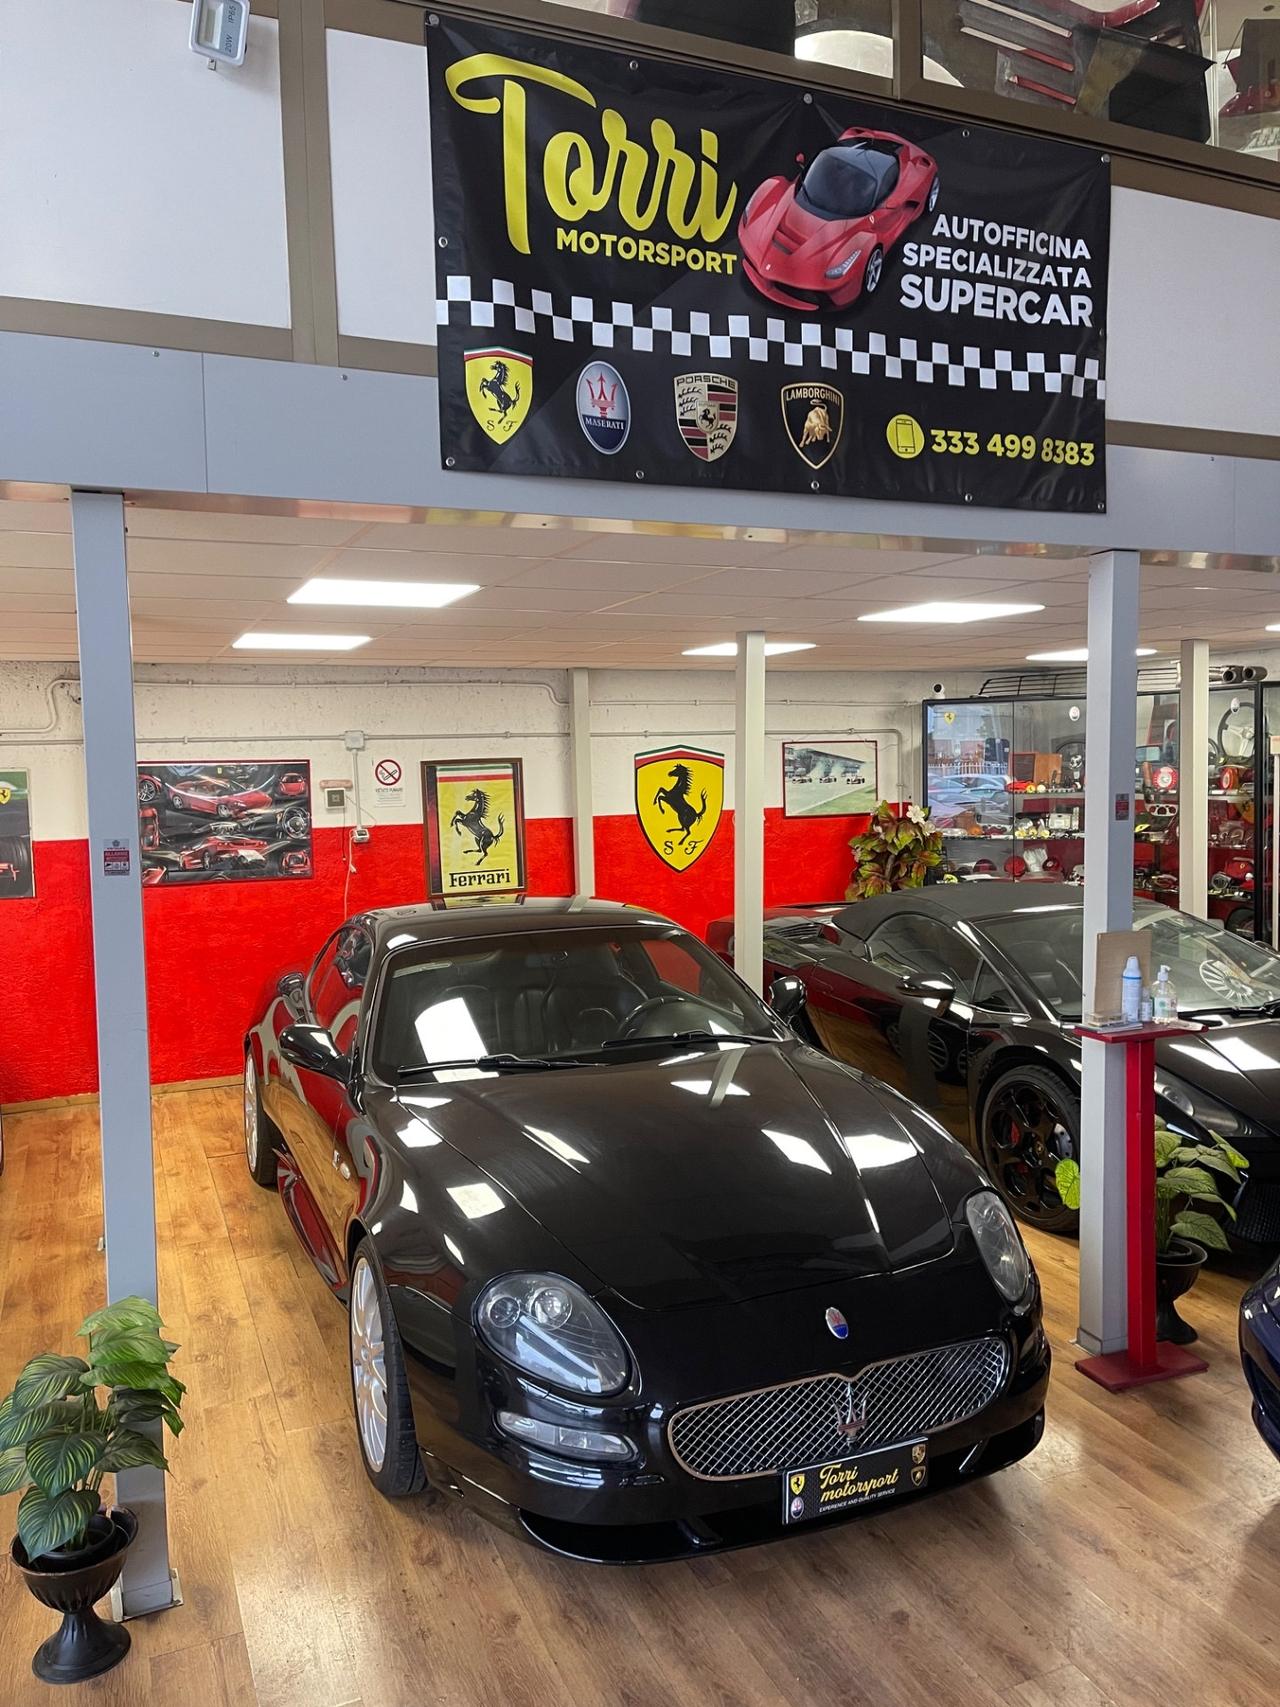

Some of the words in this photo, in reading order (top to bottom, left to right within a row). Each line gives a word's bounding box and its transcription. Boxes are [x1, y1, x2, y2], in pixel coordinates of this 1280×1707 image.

[224, 34, 233, 53] 20W
[445, 53, 738, 255] Torri
[932, 213, 1092, 261] AUTOFFICINA
[556, 228, 738, 275] MOTORSPORT
[902, 242, 1092, 289] SPECIALIZZATA
[900, 273, 1094, 328] SUPERCAR
[676, 374, 737, 390] PORSCHE
[786, 387, 840, 407] LAMBORGHINI
[486, 419, 495, 432] S
[585, 416, 625, 430] MASERATI
[930, 429, 980, 455] 333
[986, 433, 1037, 460] 499
[1041, 437, 1095, 467] 8383
[663, 840, 674, 855] S
[449, 868, 511, 888] Ferrari
[819, 1463, 858, 1489] Torri
[820, 1468, 899, 1502] motorsport
[819, 1501, 847, 1512] EXPERIENCE
[848, 1498, 858, 1506] AND
[858, 1493, 877, 1503] QUALITY
[877, 1488, 896, 1497] SERVICE
